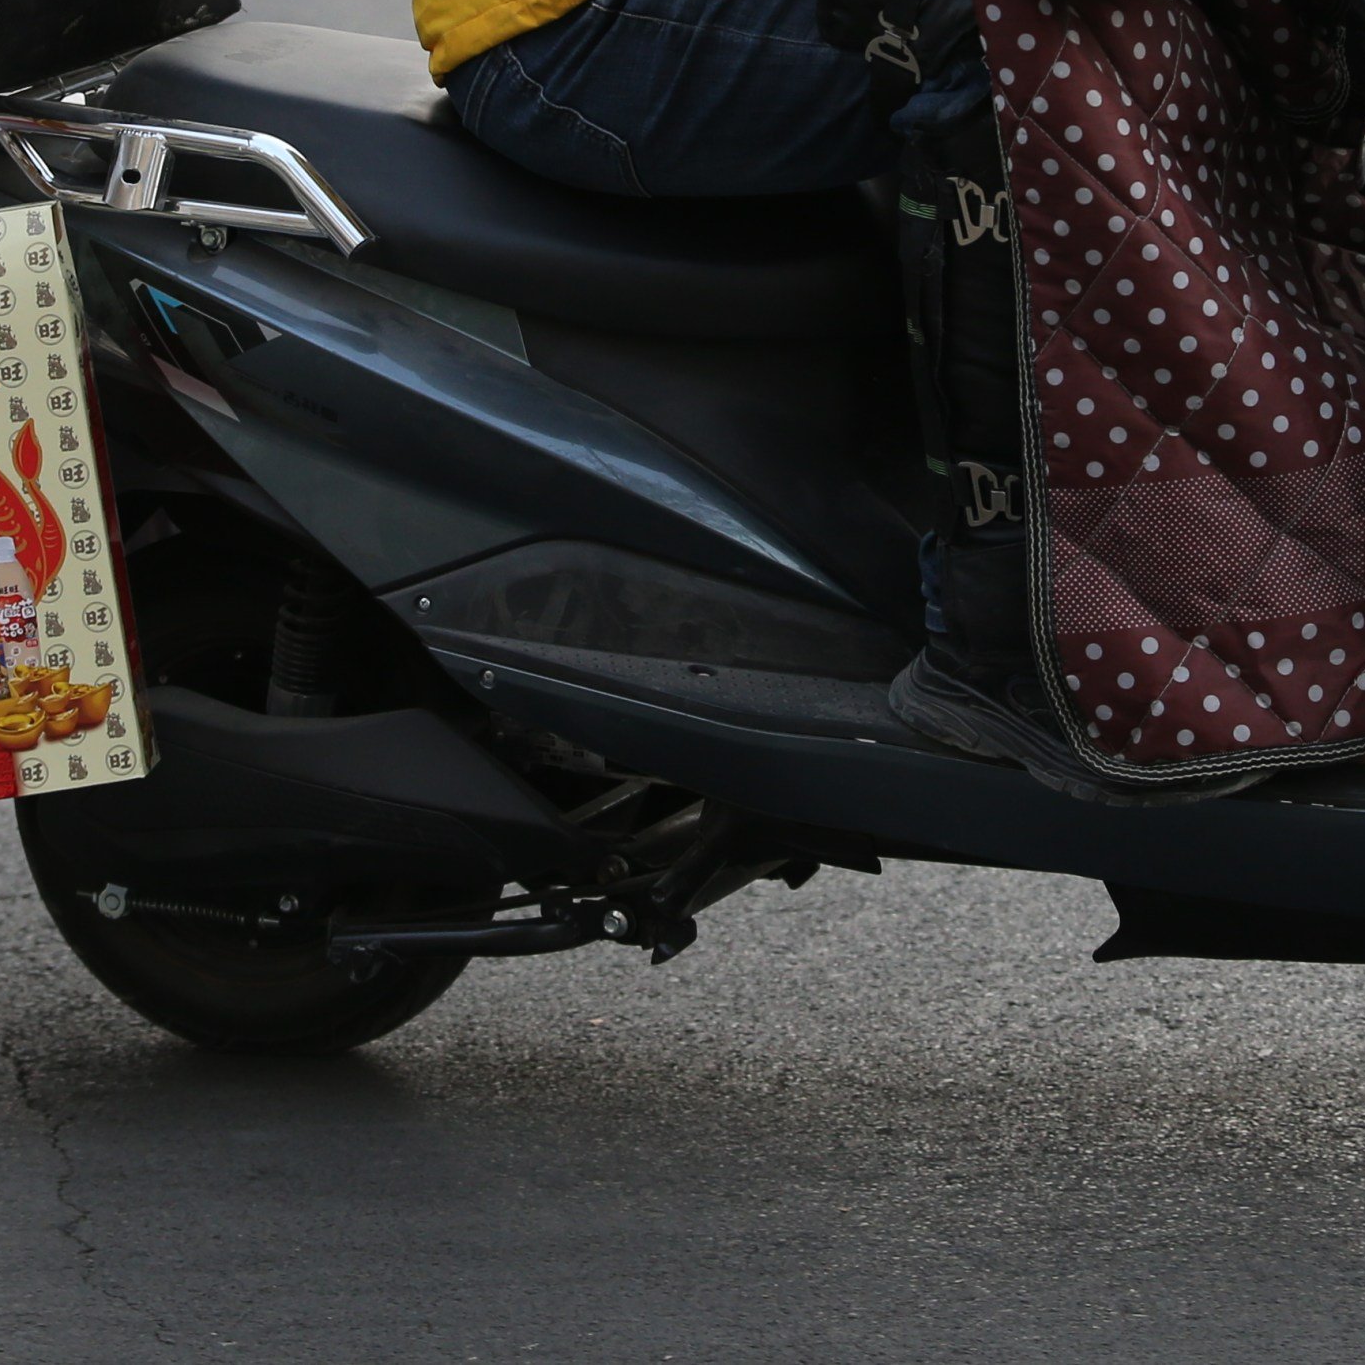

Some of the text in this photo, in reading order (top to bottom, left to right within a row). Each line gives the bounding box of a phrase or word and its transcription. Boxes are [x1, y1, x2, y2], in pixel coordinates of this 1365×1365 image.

[27, 248, 50, 266] 旺
[38, 320, 61, 338] 旺
[0, 362, 22, 382] 旺
[50, 392, 73, 411] 旺
[62, 465, 86, 483] 旺
[73, 536, 97, 554] 旺
[85, 609, 109, 627] 旺
[48, 651, 71, 669] 旺
[109, 752, 133, 769] 旺
[21, 765, 45, 783] 旺
